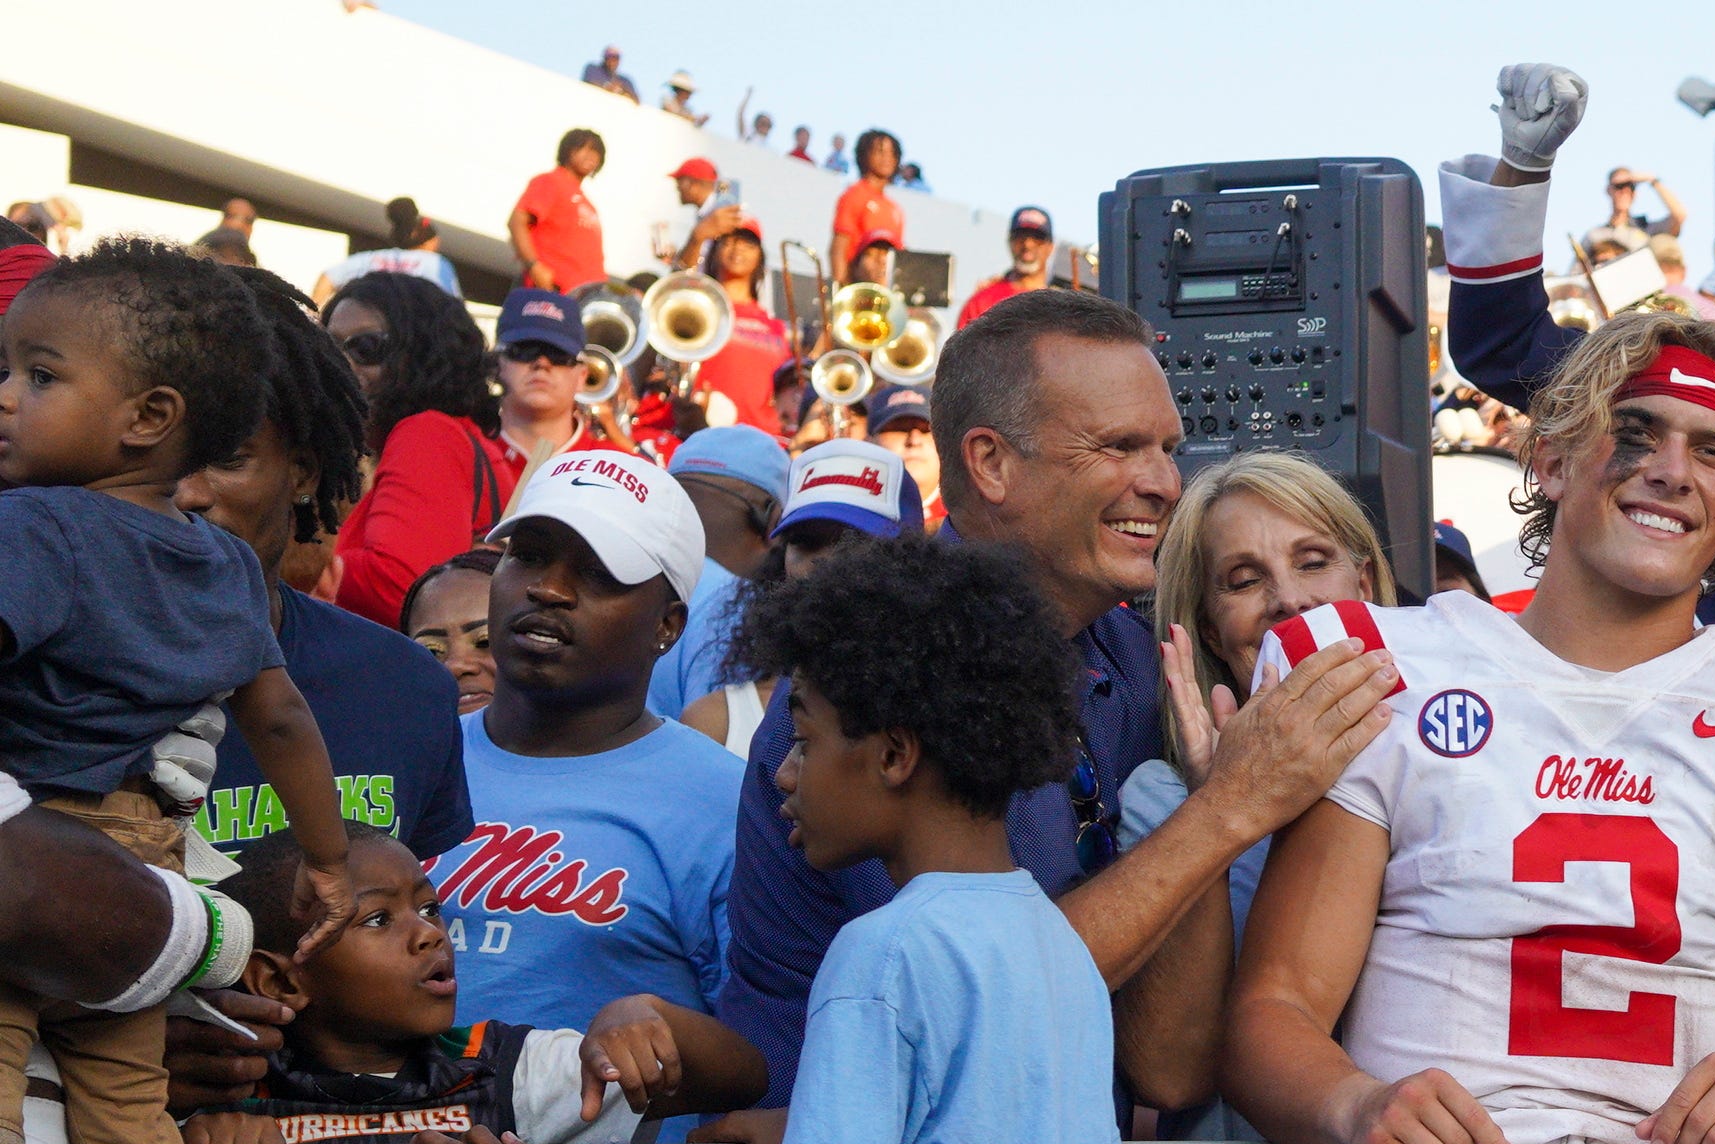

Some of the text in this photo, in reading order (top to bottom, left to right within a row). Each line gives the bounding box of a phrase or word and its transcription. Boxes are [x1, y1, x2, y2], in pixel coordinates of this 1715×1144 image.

[1203, 332, 1233, 341] Sound
[1235, 330, 1273, 339] Machine
[550, 458, 649, 503] OLE MISS
[1424, 694, 1486, 752] SEC
[1534, 754, 1656, 805] Ole Miss
[435, 820, 629, 927] Miss
[448, 917, 513, 955] AD
[1507, 812, 1683, 1067] 2
